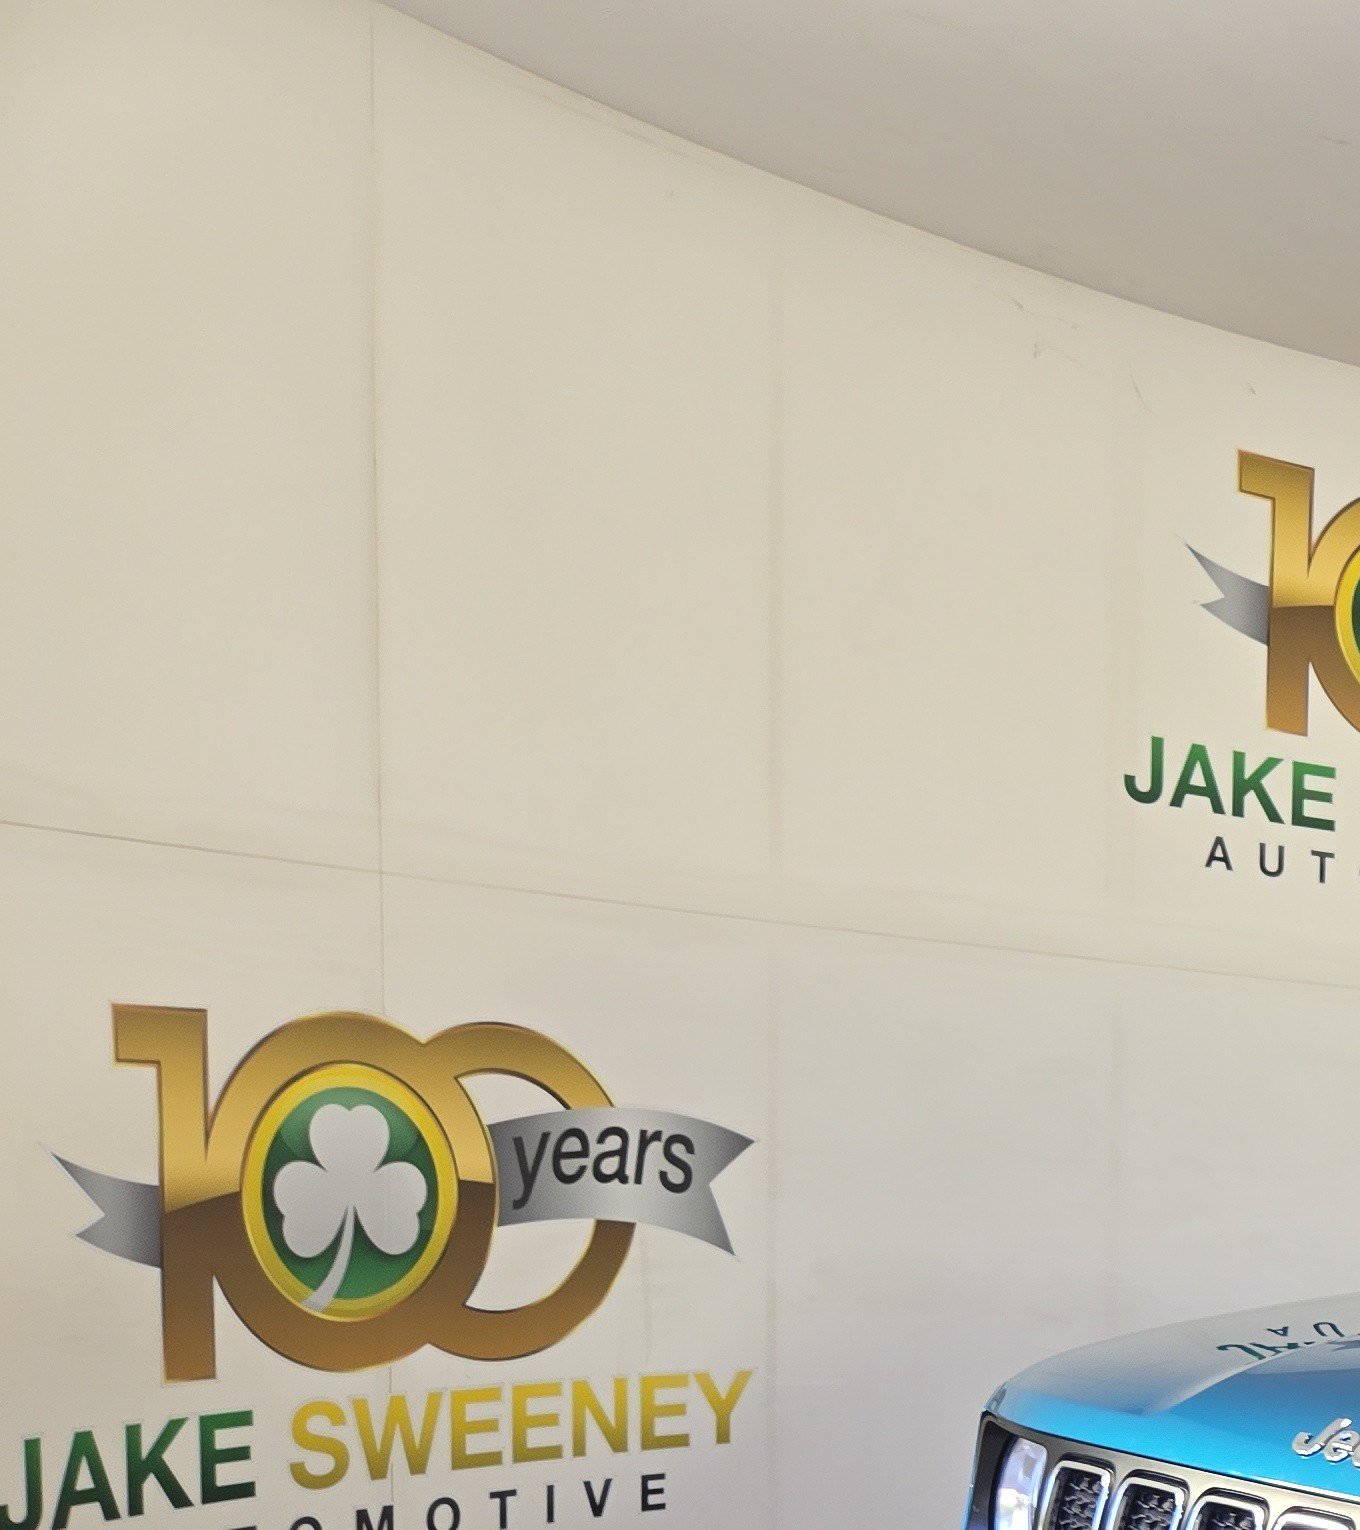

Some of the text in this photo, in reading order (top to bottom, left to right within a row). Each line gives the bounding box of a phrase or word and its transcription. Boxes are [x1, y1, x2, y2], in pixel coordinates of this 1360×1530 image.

[1123, 736, 1338, 832] JAKE
[111, 1003, 696, 1384] 100 years
[288, 1369, 754, 1492] SWEENEY
